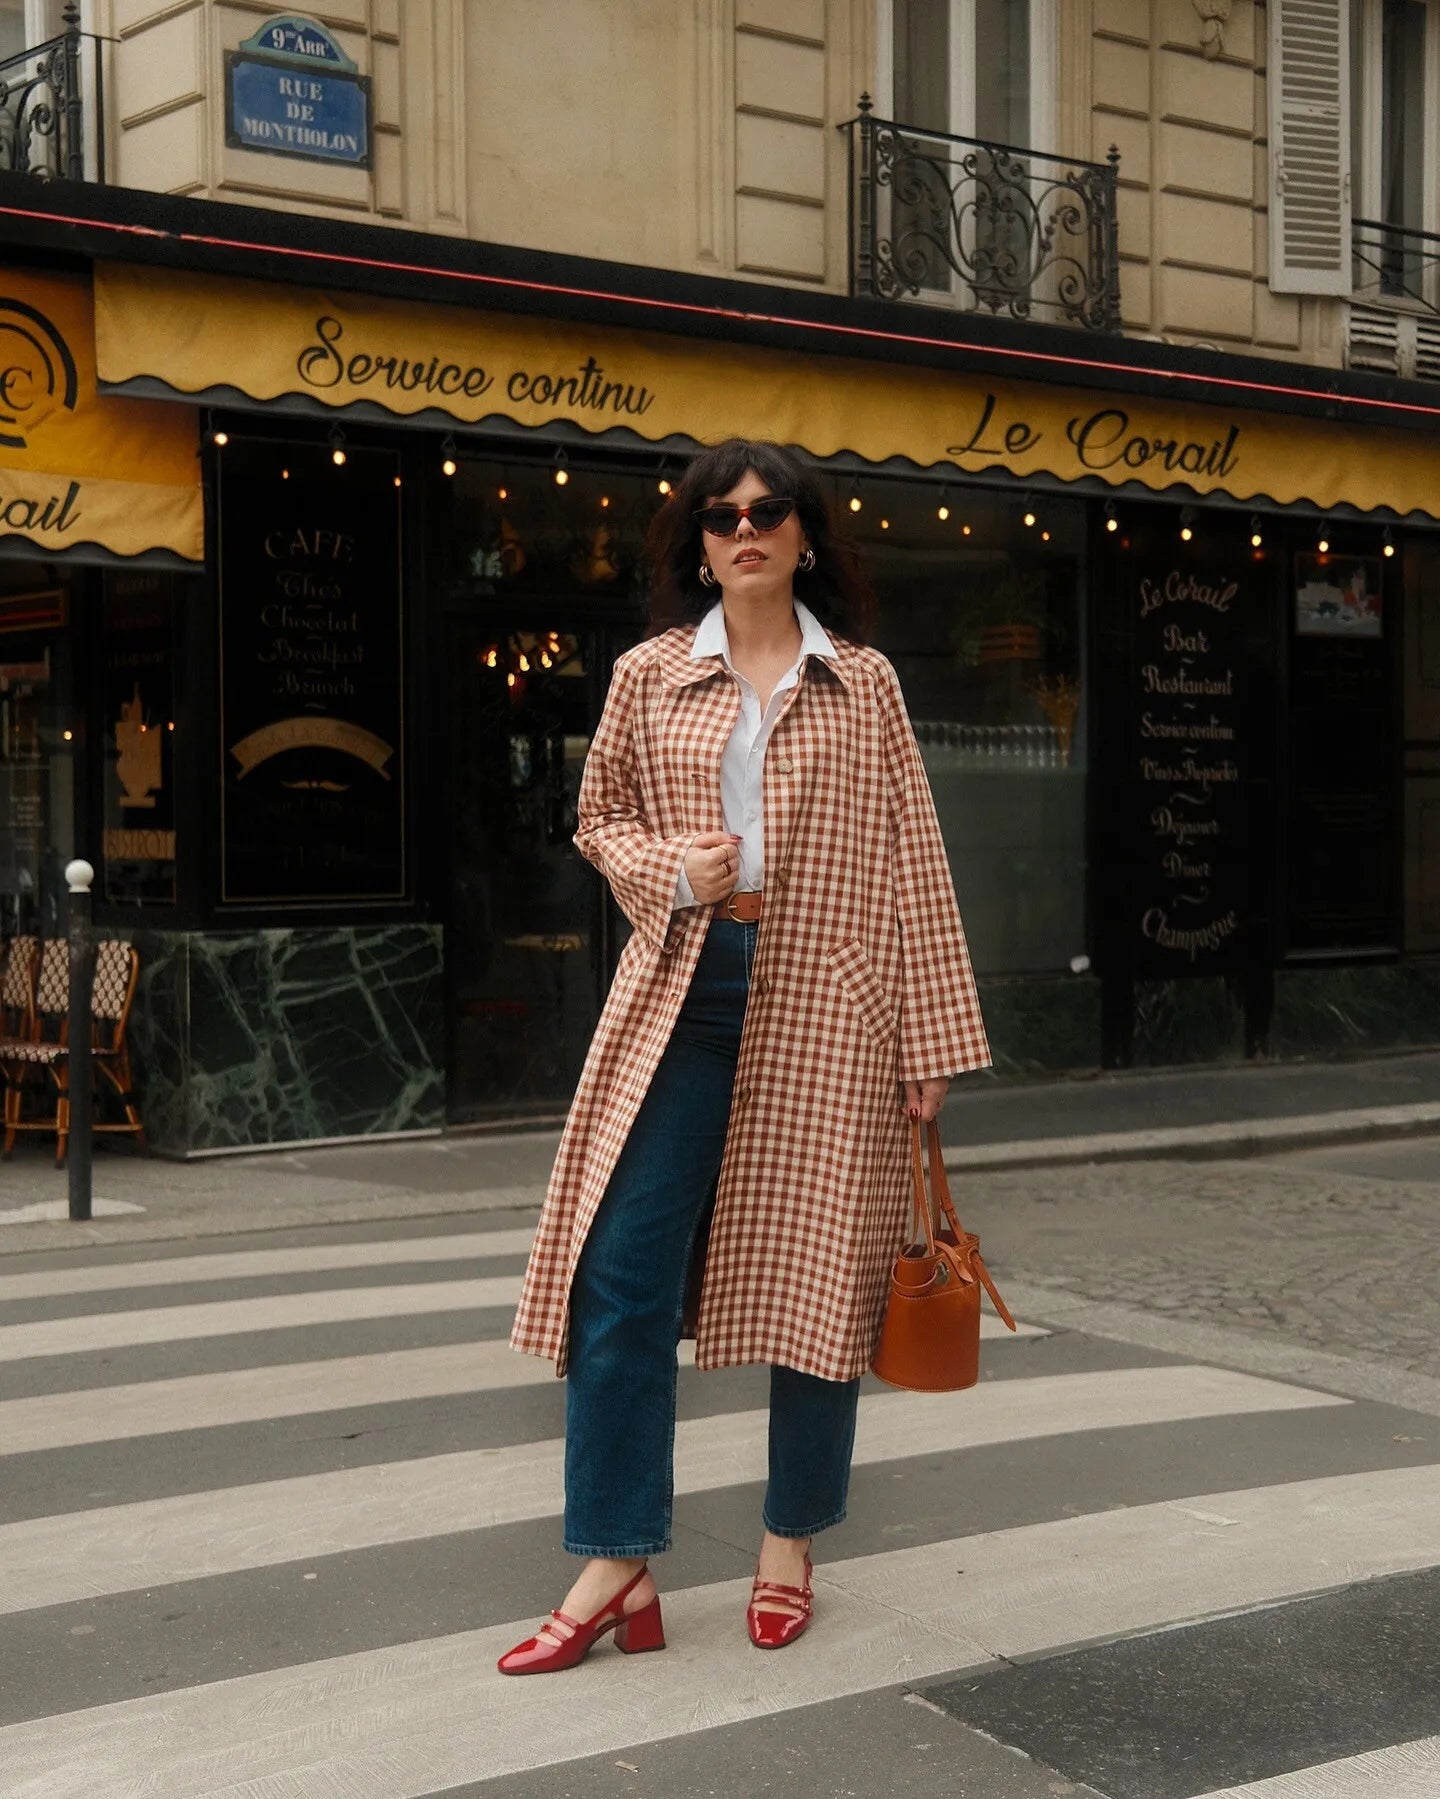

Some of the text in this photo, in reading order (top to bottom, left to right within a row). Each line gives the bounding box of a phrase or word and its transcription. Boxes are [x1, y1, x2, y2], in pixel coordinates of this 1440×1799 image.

[279, 77, 323, 101] RUE
[287, 102, 314, 122] DE
[242, 117, 358, 152] MONTHOLON
[297, 316, 655, 415] Service continu
[946, 393, 1240, 478] Le Corail
[0, 481, 82, 532] ail
[1139, 569, 1239, 620] Le Corail
[1162, 623, 1210, 653] Bar
[1141, 664, 1233, 695] Restaurant
[1142, 907, 1238, 962] Champagne
